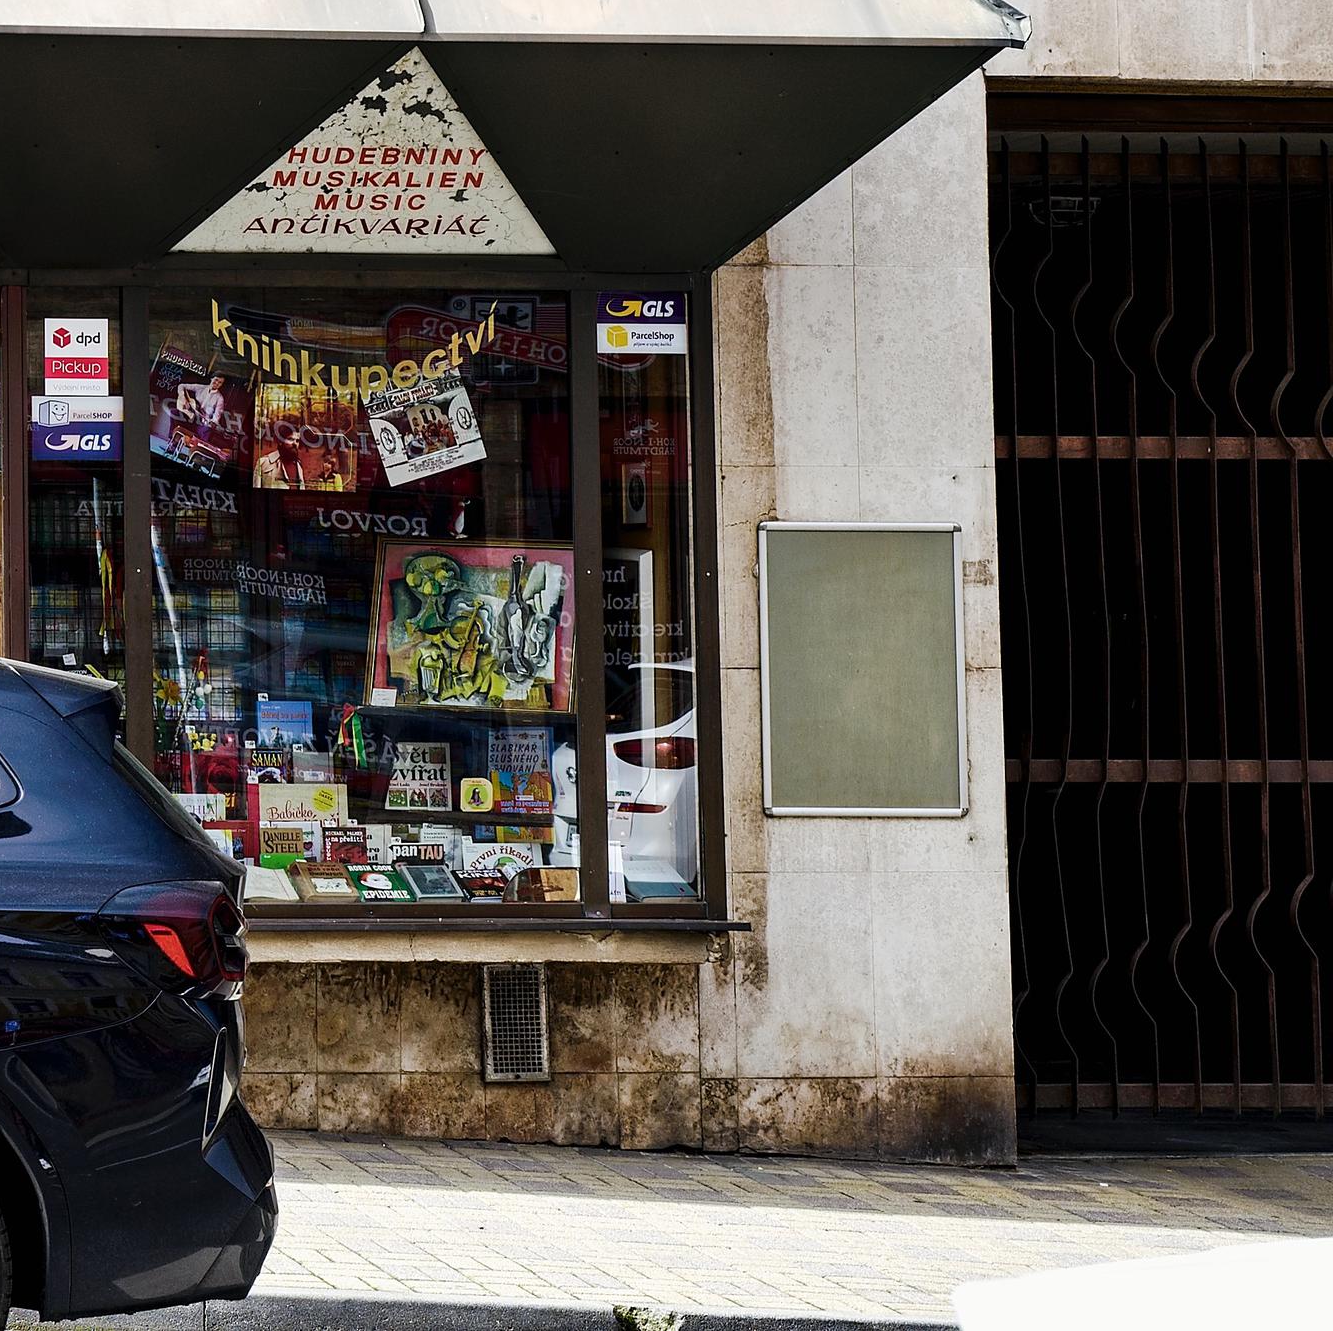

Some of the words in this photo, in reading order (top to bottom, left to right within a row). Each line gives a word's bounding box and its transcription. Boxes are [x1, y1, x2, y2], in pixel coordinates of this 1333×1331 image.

[287, 146, 487, 165] HUDEBNINY
[273, 170, 484, 189] MUSIKALIEN
[314, 193, 426, 212] MUSIC
[642, 301, 675, 318] GLS
[76, 332, 101, 347] dpd
[630, 331, 675, 341] ParcelShop
[211, 298, 499, 399] knihkupectví
[52, 360, 101, 374] Pickup
[80, 434, 111, 451] GLS
[251, 750, 283, 767] ŠAMAN
[267, 800, 318, 820] Babičko,
[263, 830, 302, 843] DANIELLE
[265, 840, 303, 854] STEEL
[393, 845, 418, 859] pan
[419, 845, 443, 860] TAU
[470, 848, 496, 869] První
[499, 844, 534, 869] říkadl
[347, 864, 371, 872] ROBIN
[372, 864, 394, 872] COOK
[458, 870, 502, 879] KING
[364, 890, 411, 899] EPIDEMIE
